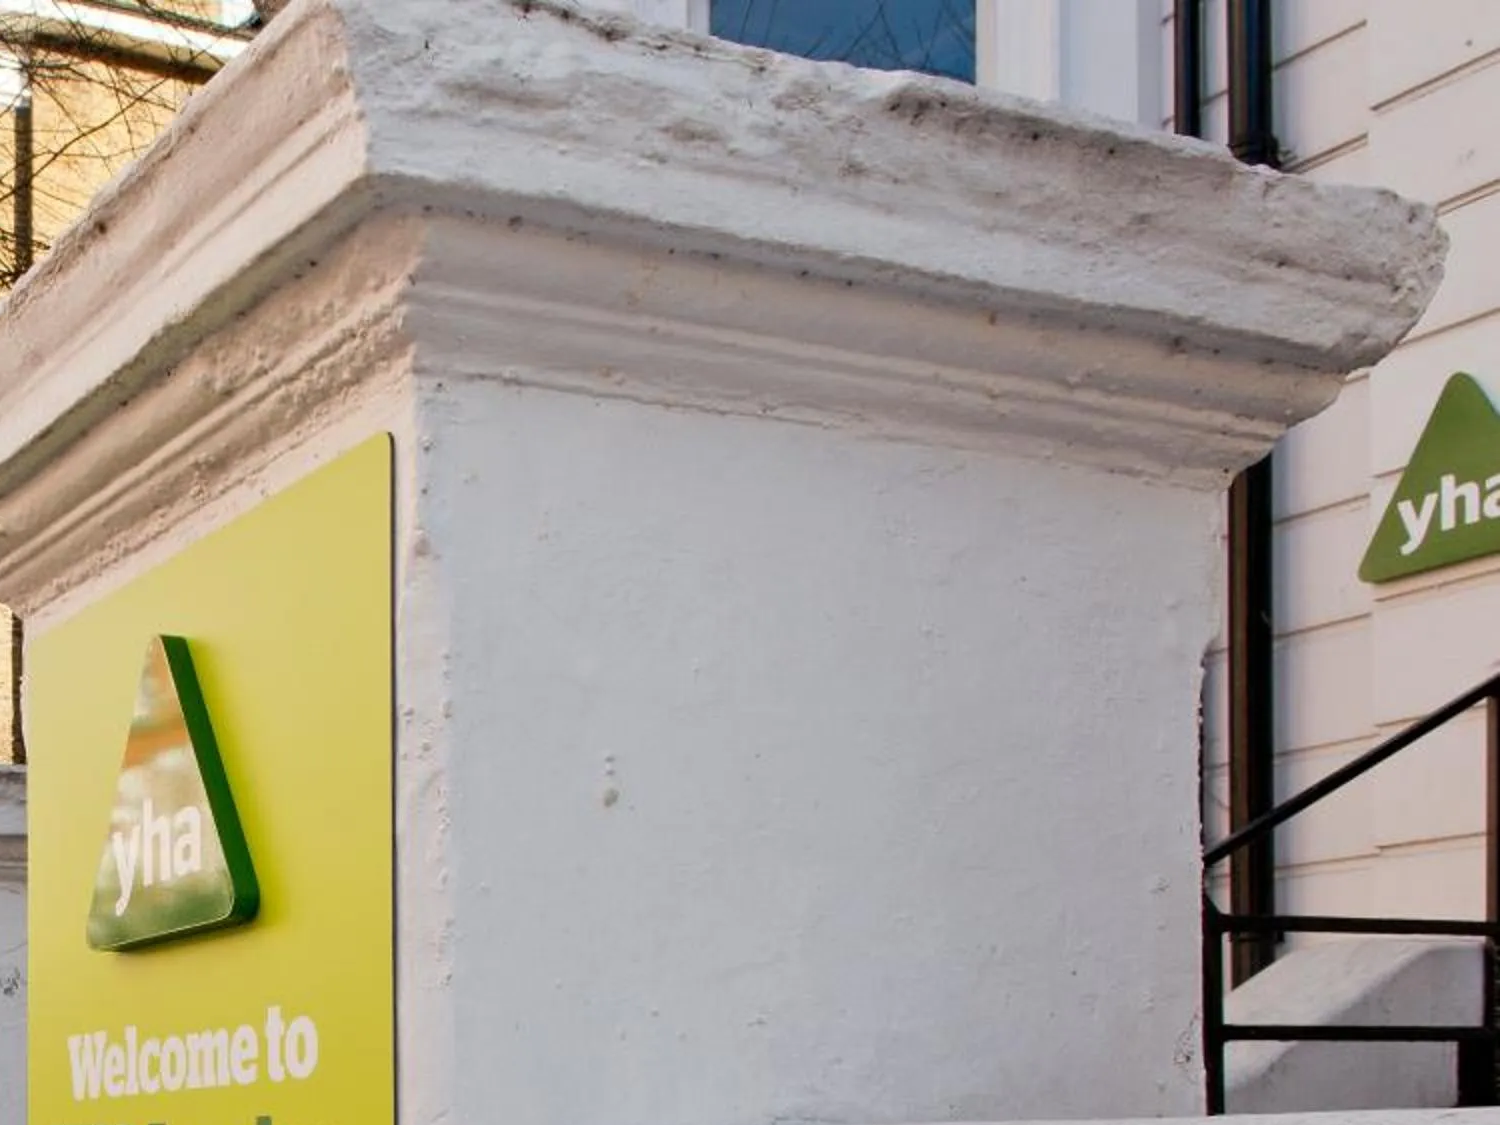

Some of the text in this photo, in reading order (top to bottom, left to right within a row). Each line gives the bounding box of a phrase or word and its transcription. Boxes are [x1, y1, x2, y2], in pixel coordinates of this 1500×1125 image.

[111, 798, 202, 916] yha
[67, 1005, 319, 1101] Welcome to
